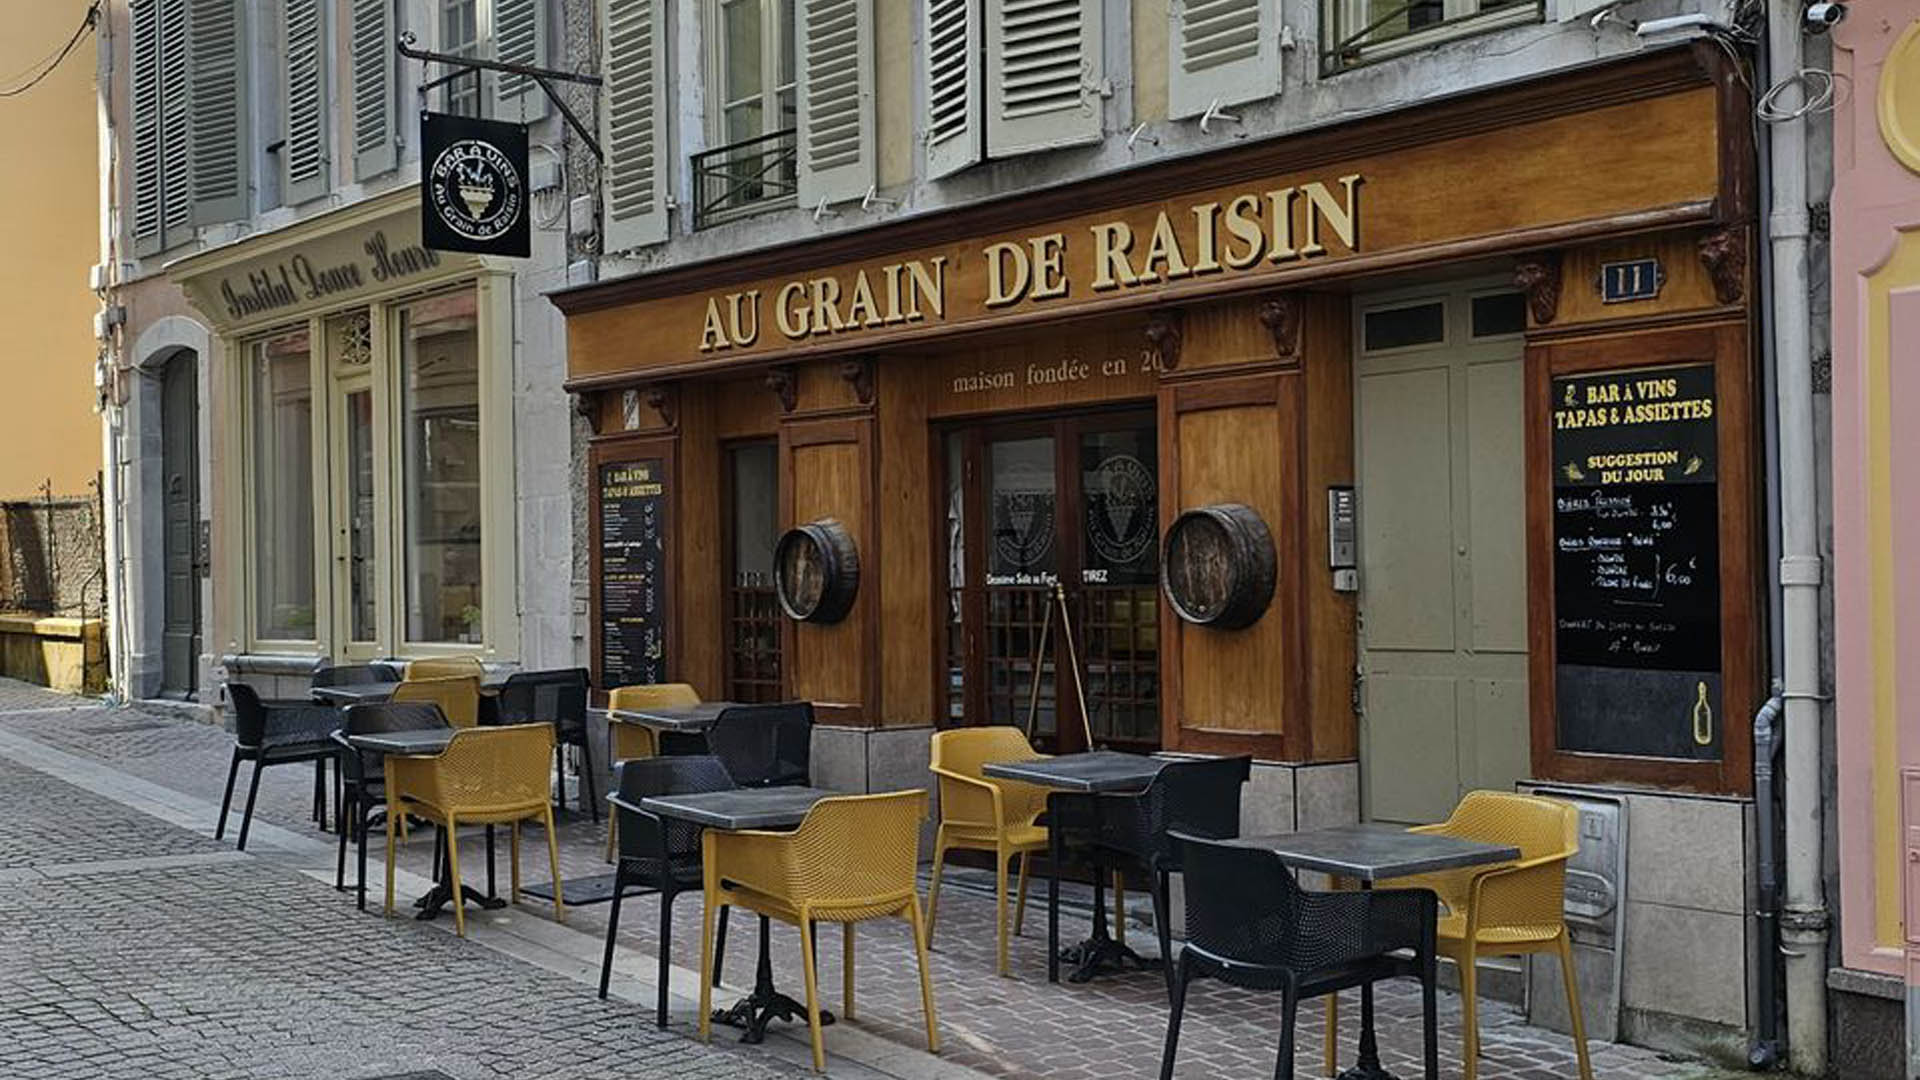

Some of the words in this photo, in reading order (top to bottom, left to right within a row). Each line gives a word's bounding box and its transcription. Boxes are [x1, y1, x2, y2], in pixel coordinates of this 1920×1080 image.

[436, 146, 466, 178] BAR
[443, 207, 474, 233] Grain
[477, 224, 493, 236] de
[493, 193, 517, 231] Raisin
[699, 289, 760, 350] AU
[776, 255, 946, 338] GRAIN
[983, 232, 1068, 306] DE
[1090, 173, 1362, 289] RAISIN
[1617, 265, 1641, 295] 11
[953, 370, 1015, 393] maison
[1026, 358, 1090, 386] fondée
[1102, 358, 1126, 377] en
[1586, 384, 1621, 405] BAR
[1636, 378, 1677, 400] VINS
[1554, 407, 1608, 430] TAPAS
[1611, 409, 1620, 425] &
[1624, 399, 1713, 425] ASSIETTES
[1586, 450, 1679, 469] SUGGESTION
[1601, 470, 1622, 485] DU
[1624, 468, 1665, 484] JOUR
[1082, 569, 1108, 583] TIREZ
